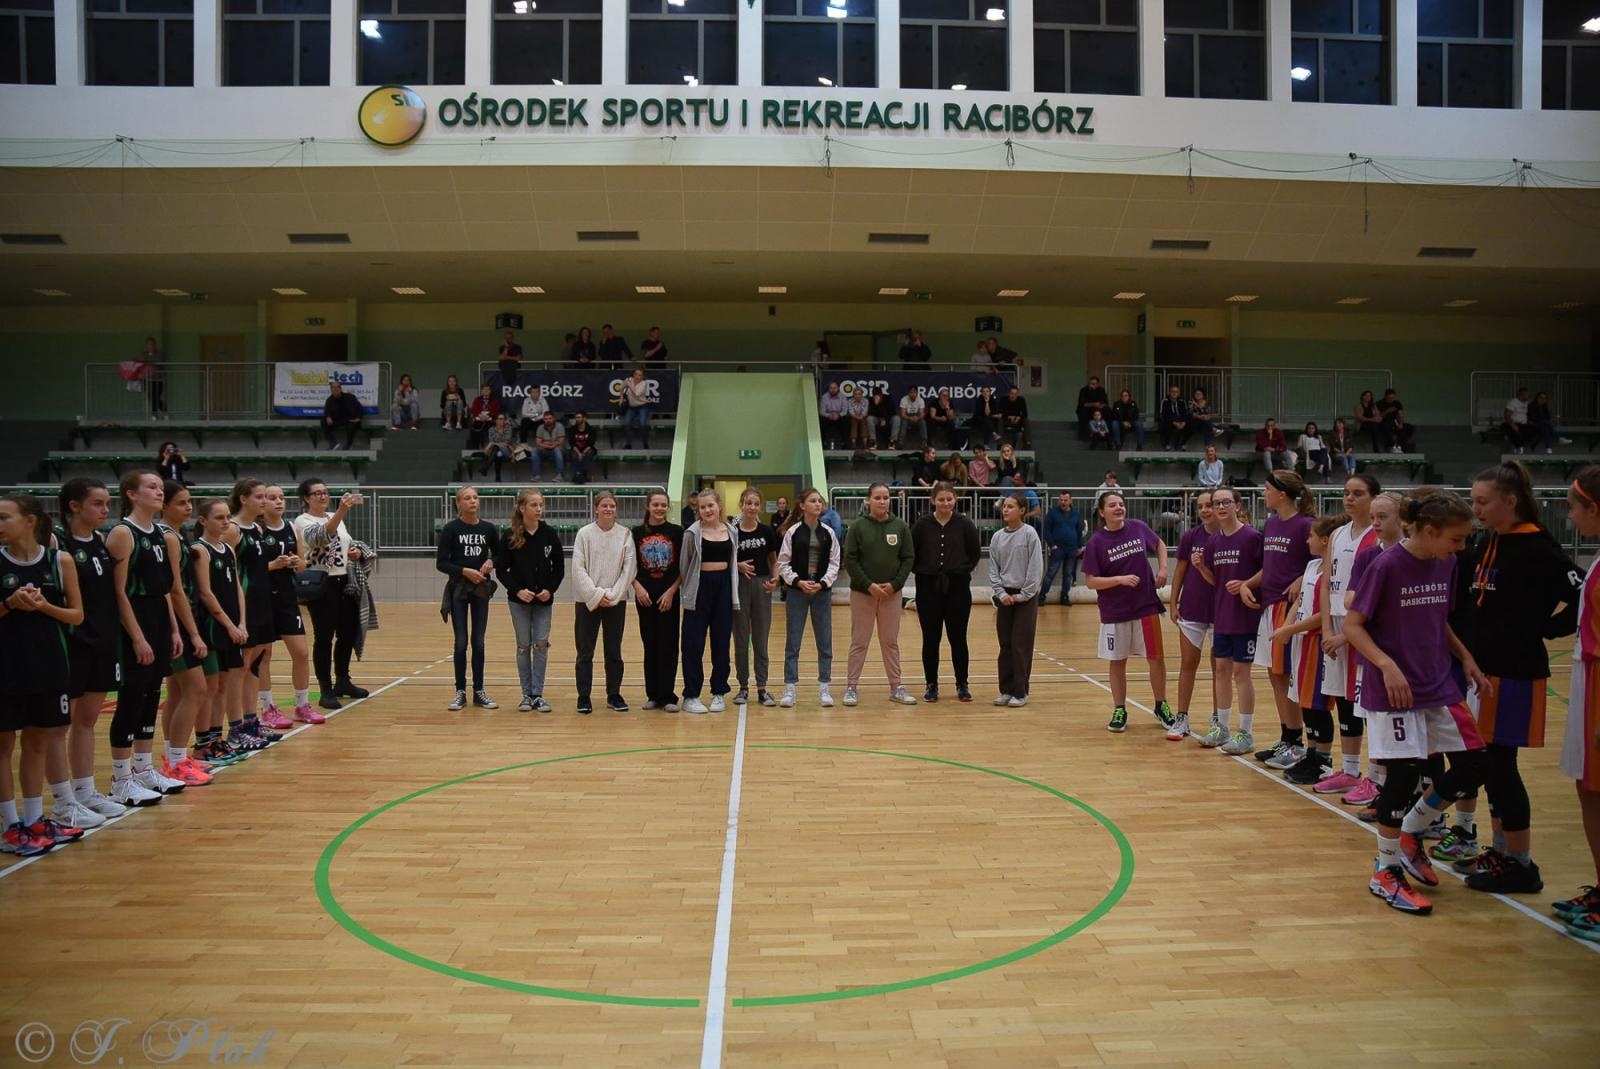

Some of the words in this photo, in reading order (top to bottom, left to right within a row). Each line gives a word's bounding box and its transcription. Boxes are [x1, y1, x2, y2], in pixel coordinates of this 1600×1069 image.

[438, 92, 589, 127] OŚRODEK
[602, 98, 730, 127] SPORTU
[742, 99, 747, 127] I
[763, 99, 929, 131] REKREACJI
[944, 99, 1095, 134] RACIBÓRZ
[502, 381, 583, 398] RACBÓRZ
[459, 534, 487, 545] WEEK
[1107, 539, 1141, 555] RACIBÓRZ
[152, 545, 163, 563] 10
[464, 545, 482, 556] END
[1109, 547, 1144, 563] BASKETBALL
[92, 557, 103, 576] 8
[1401, 582, 1447, 595] RACIBÓRZ
[1401, 595, 1448, 607] BASKETBALL
[60, 694, 69, 714] 6
[1393, 717, 1405, 741] 5
